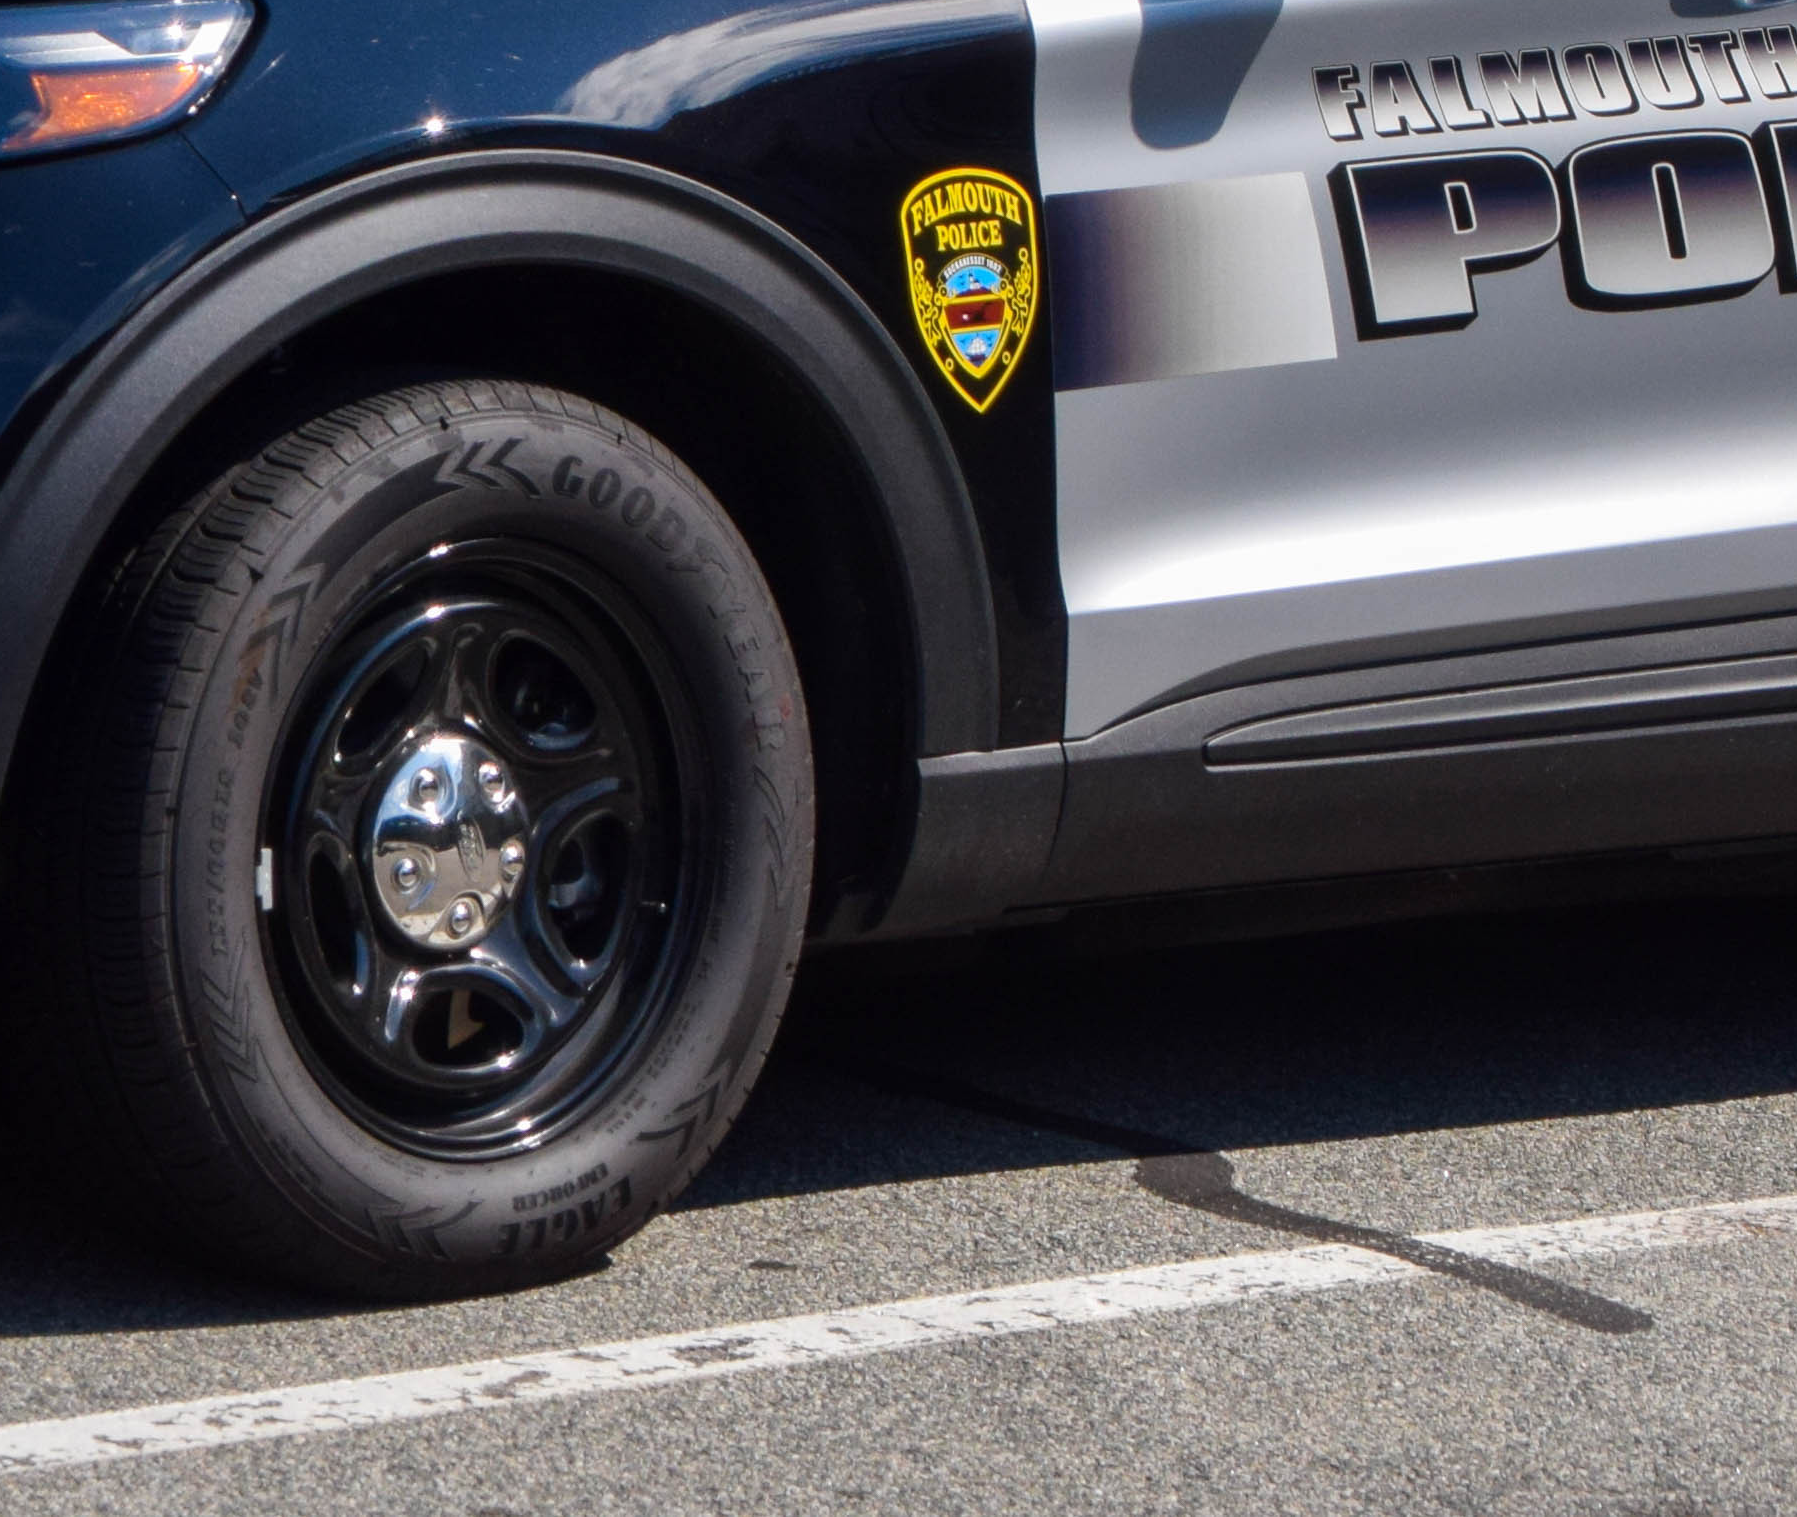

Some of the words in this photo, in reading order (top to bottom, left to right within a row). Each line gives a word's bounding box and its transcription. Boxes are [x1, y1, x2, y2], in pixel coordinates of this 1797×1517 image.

[911, 182, 1022, 235] FALMOUTH
[935, 220, 1002, 251] POLICE
[489, 1175, 632, 1255] EAGLE
